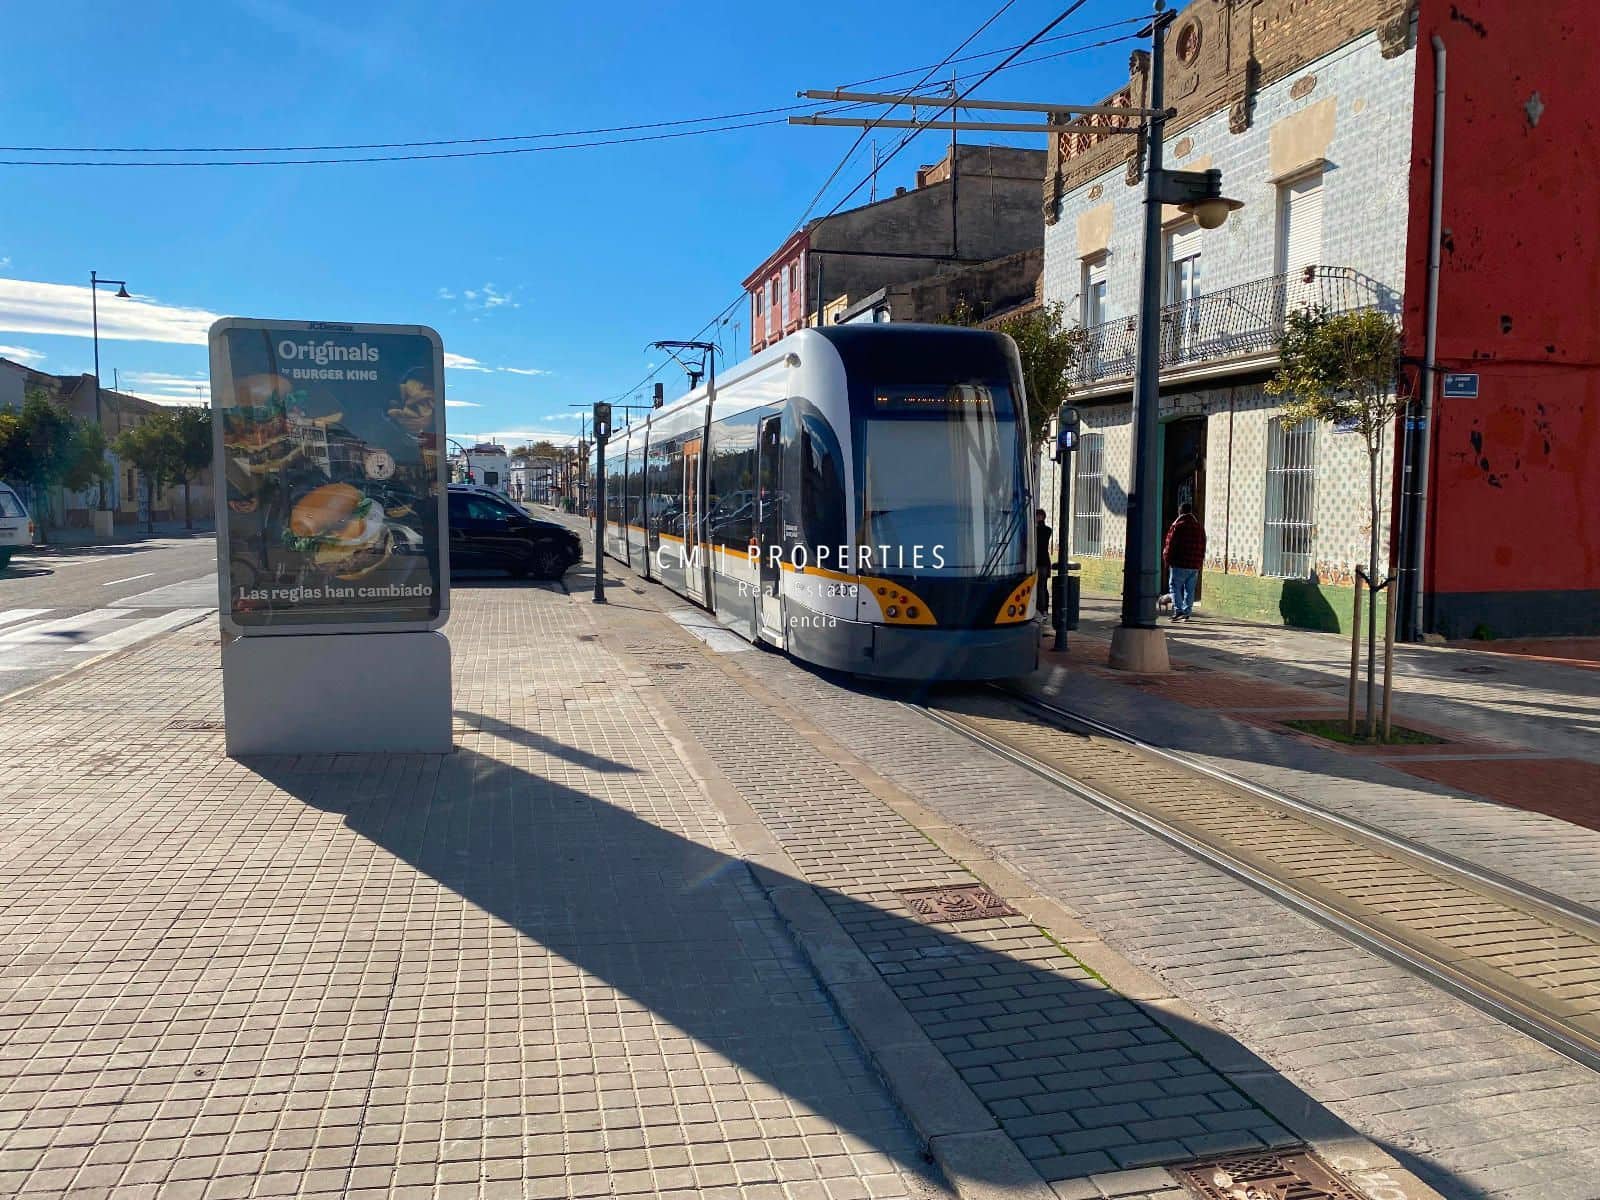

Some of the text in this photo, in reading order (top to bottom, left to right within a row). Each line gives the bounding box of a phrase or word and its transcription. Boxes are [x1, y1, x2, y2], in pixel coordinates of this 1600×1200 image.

[279, 340, 379, 365] Originals
[293, 368, 343, 380] BURGER
[346, 370, 378, 381] KING
[239, 584, 432, 602] Las reglas han cambiado
